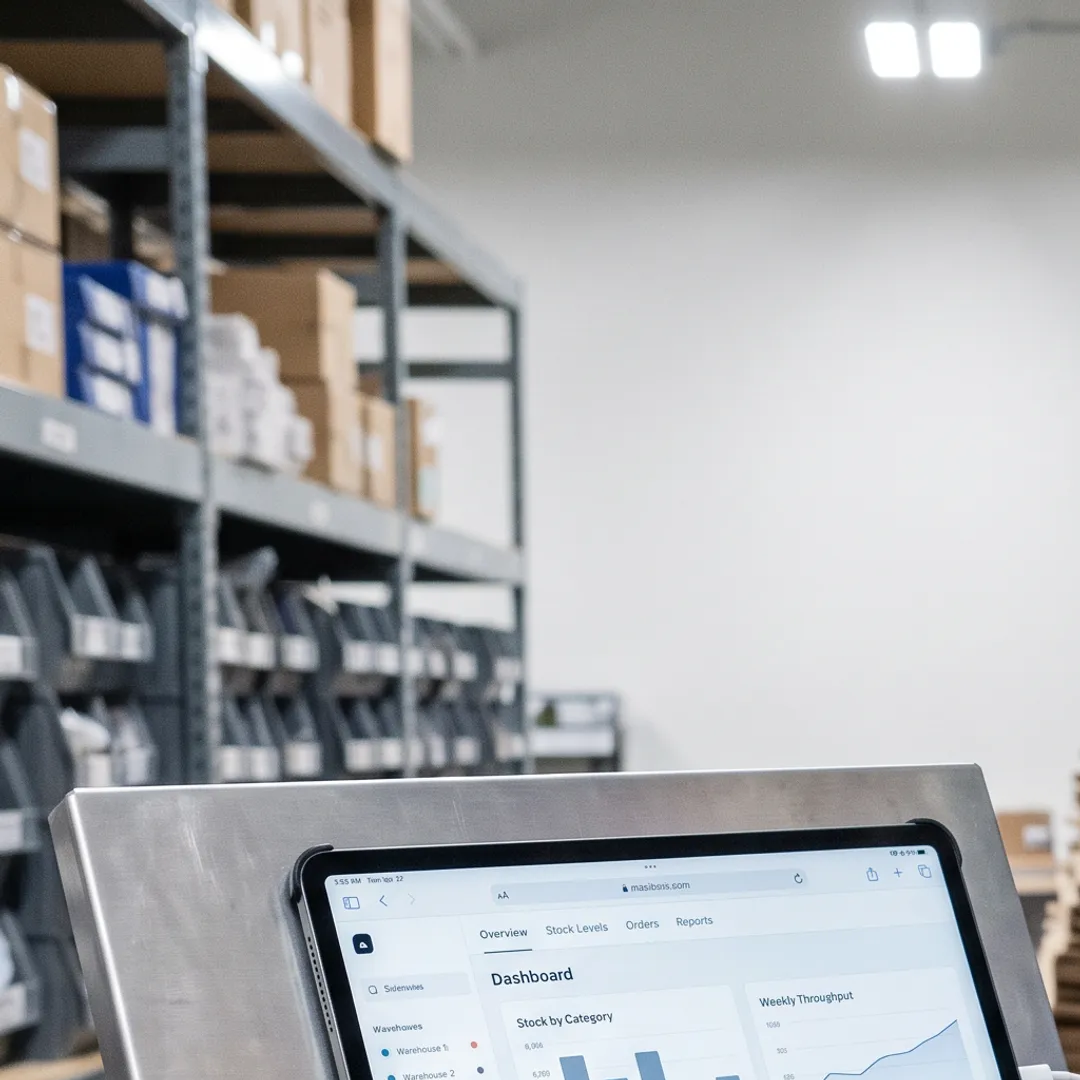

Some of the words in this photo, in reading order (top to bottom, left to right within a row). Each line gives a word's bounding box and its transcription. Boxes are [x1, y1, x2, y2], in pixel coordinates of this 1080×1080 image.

[626, 920, 659, 930] Orders
[676, 917, 713, 927] Reports
[480, 928, 527, 939] Overview
[546, 925, 574, 935] Stock
[576, 923, 608, 933] Levels
[491, 967, 573, 985] Dashboard
[759, 996, 795, 1007] Weekly
[797, 992, 853, 1004] Throughput
[517, 1017, 548, 1028] Stock
[549, 1016, 562, 1027] by
[565, 1013, 612, 1024] Category
[397, 1046, 441, 1055] Warehouse
[403, 1072, 447, 1080] Warehouse
